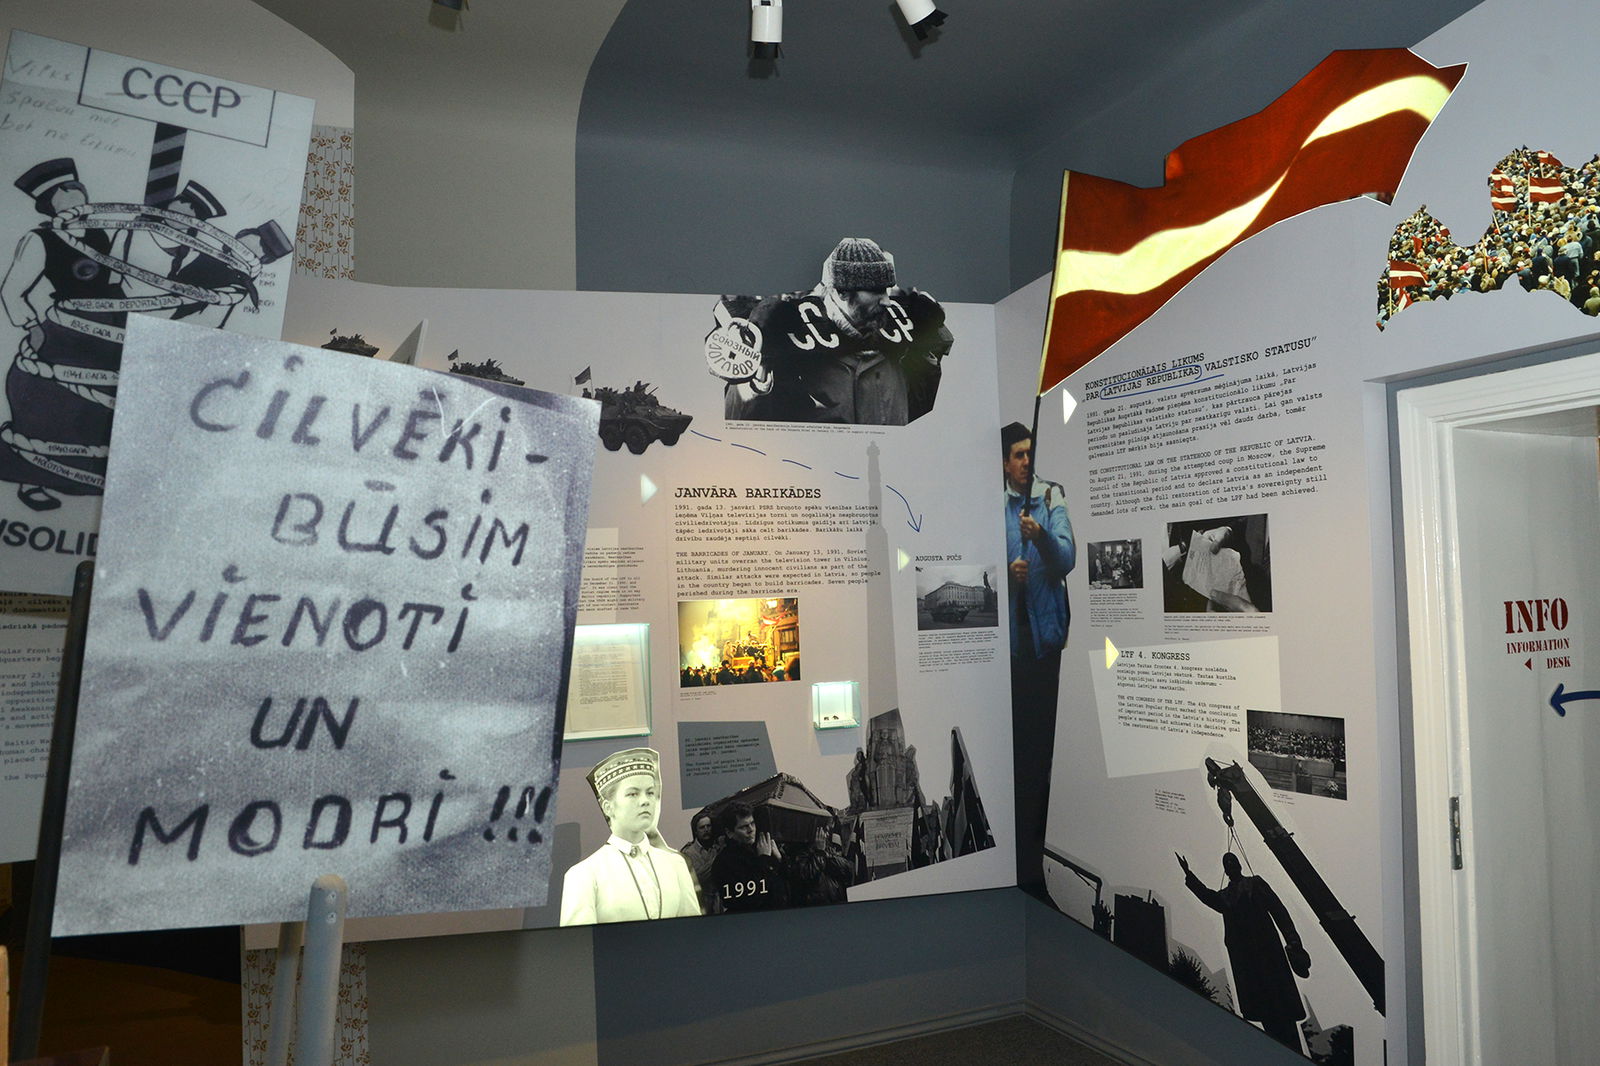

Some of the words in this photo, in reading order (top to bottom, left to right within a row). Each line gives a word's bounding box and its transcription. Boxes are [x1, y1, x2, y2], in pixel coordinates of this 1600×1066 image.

[1085, 362, 1167, 390] KONSTITUCIONĀLAIS
[1172, 352, 1206, 368] LIKUMS
[1103, 380, 1142, 397] LATVIJAS
[1146, 366, 1200, 386] REPUBLIKAS
[1204, 351, 1259, 372] VALSTISKO
[1113, 486, 1149, 496] transitional
[1152, 483, 1172, 493] period
[1226, 474, 1249, 482] Latvia
[1276, 464, 1323, 476] independent
[1116, 497, 1140, 505] Although
[1172, 489, 1209, 498] restoration
[1223, 483, 1254, 492] Latvia's
[1258, 477, 1302, 488] sovereignty
[1306, 473, 1327, 482] still
[674, 485, 738, 498] JANVĀRA
[746, 486, 822, 499] BARIKĀDES
[271, 479, 530, 567] BŪSIM
[782, 571, 810, 579] expected
[847, 577, 868, 585] people
[677, 589, 707, 598] perished
[1504, 597, 1568, 634] INFO
[1152, 652, 1191, 661] KONGRESS
[1506, 638, 1570, 654] INFORMATION
[1547, 656, 1571, 669] DESK
[249, 697, 360, 751] UN
[722, 878, 769, 900] 1991
